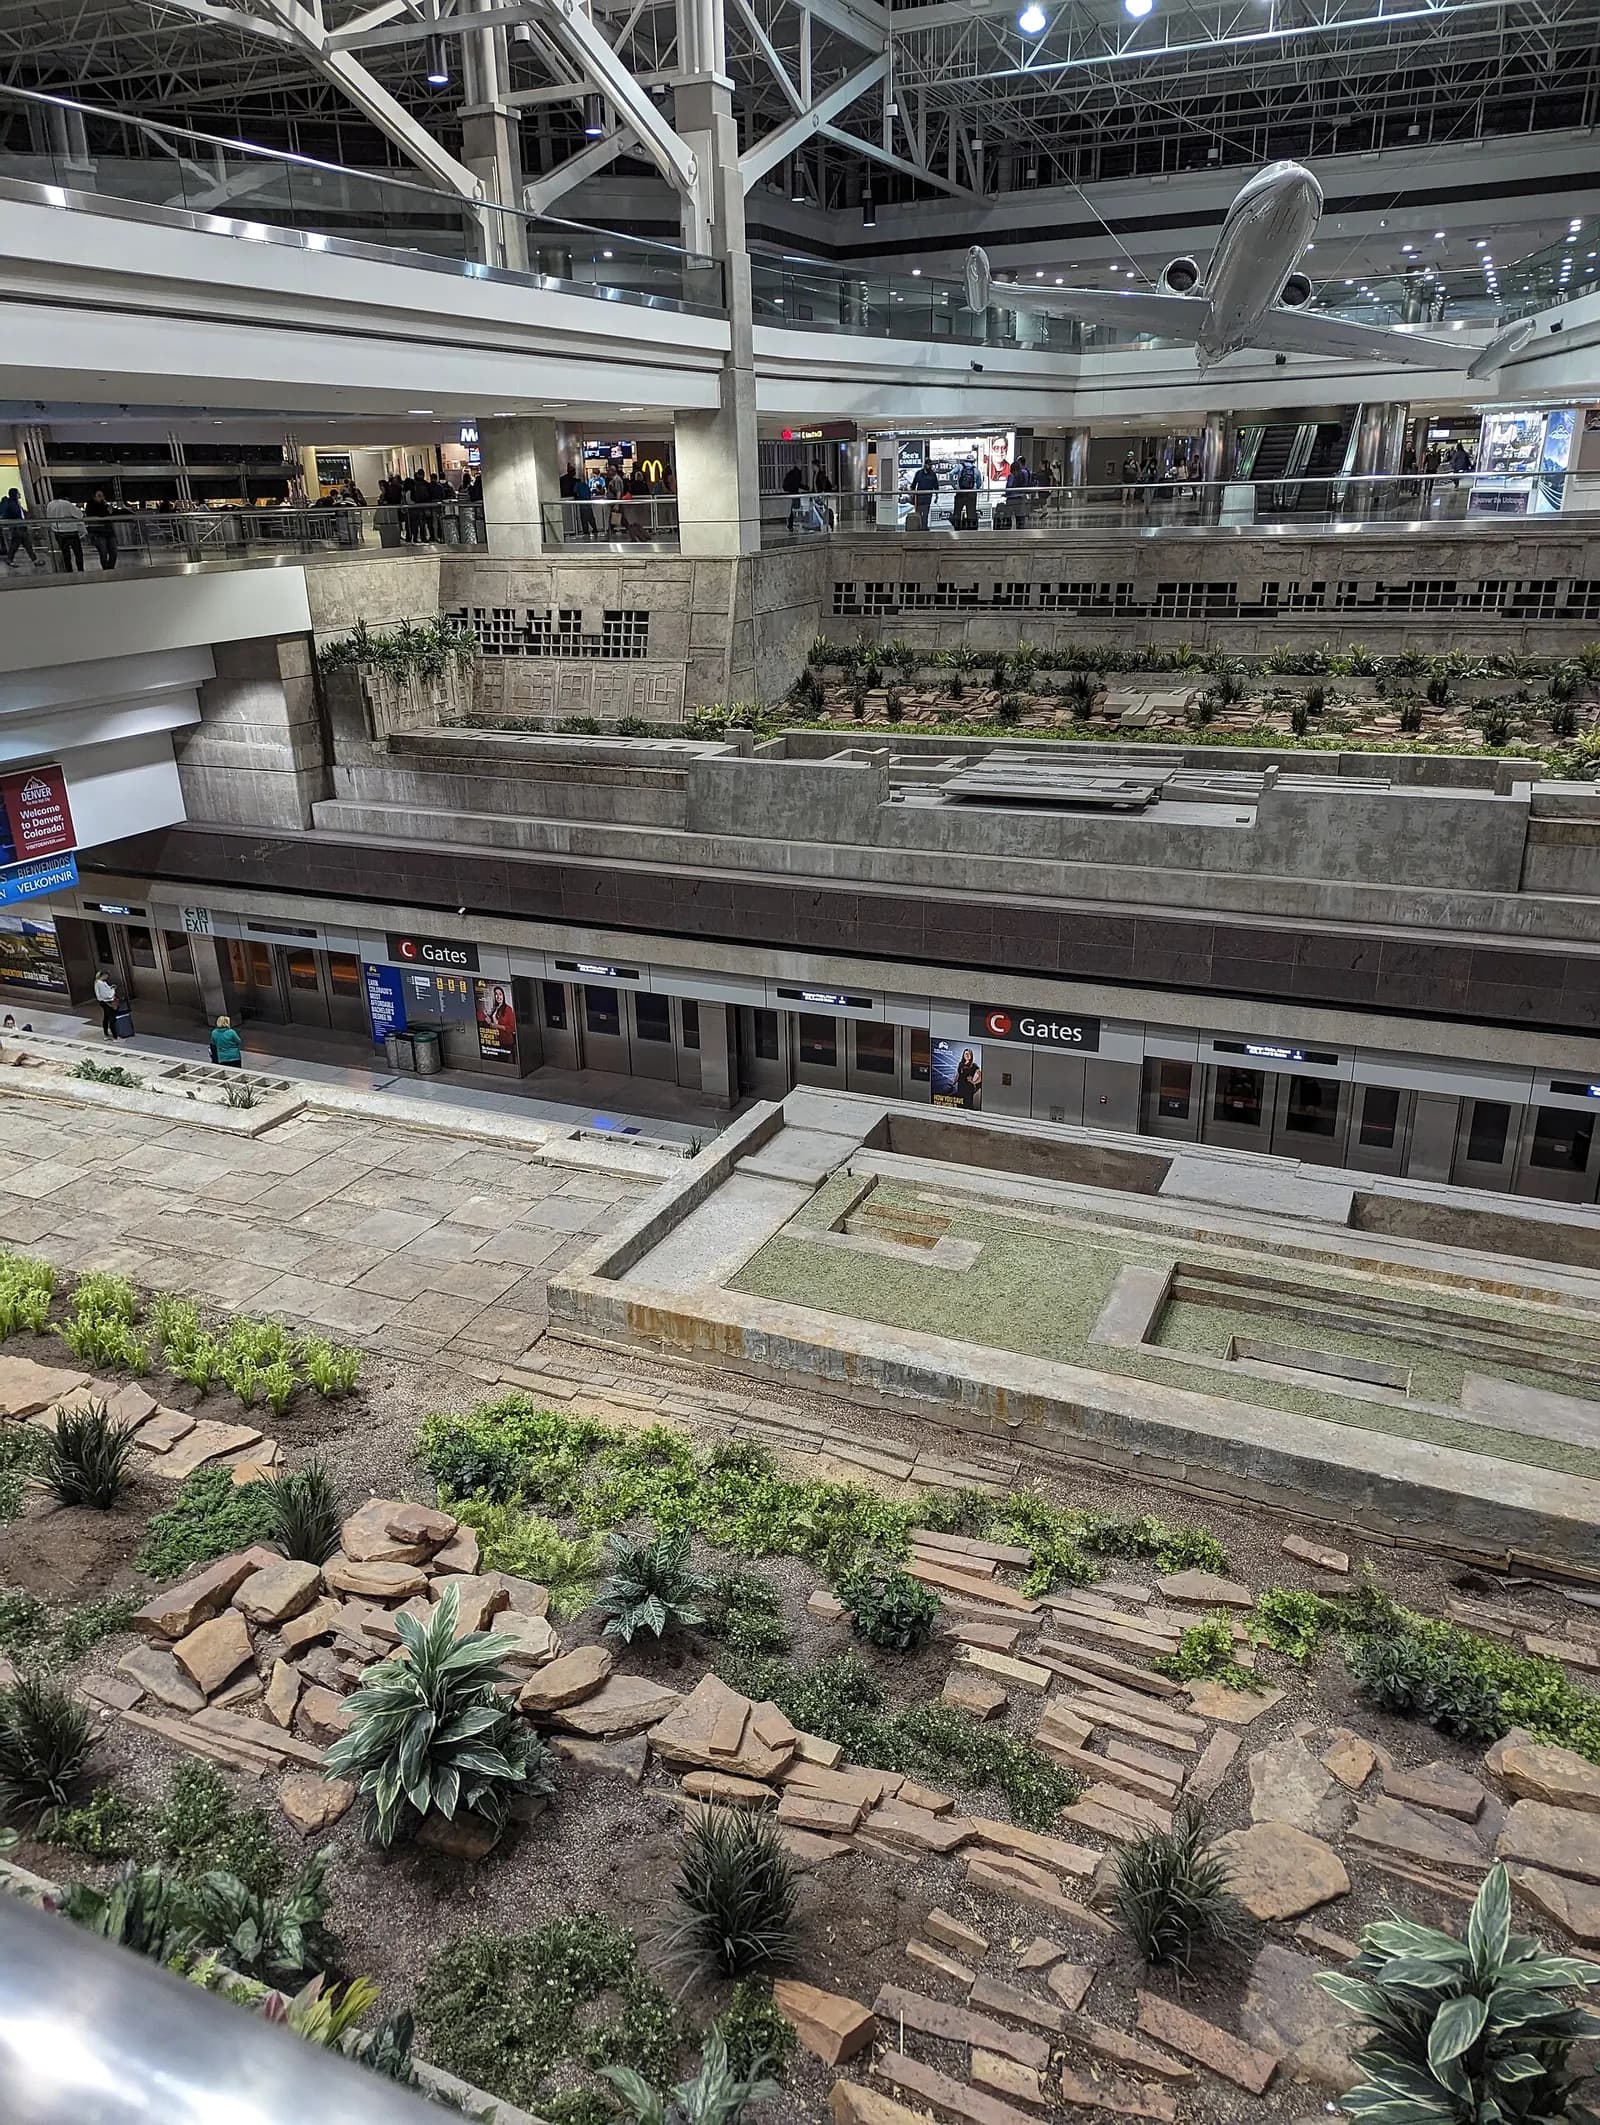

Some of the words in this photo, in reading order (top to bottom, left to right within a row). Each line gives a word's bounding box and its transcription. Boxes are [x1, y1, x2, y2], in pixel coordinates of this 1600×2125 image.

[902, 451, 919, 459] See's
[21, 787, 52, 802] DENVER
[20, 805, 60, 819] Welcome
[21, 822, 31, 830] to
[32, 814, 64, 827] Denver,
[23, 822, 65, 839] Colorado!
[17, 856, 71, 880] BIENVENIDOS
[17, 870, 74, 894] VELKOMNIR
[185, 919, 209, 933] EXIT
[402, 942, 413, 957] C
[422, 944, 467, 964] Gates
[990, 1014, 1004, 1032] C
[1020, 1018, 1082, 1042] Gates
